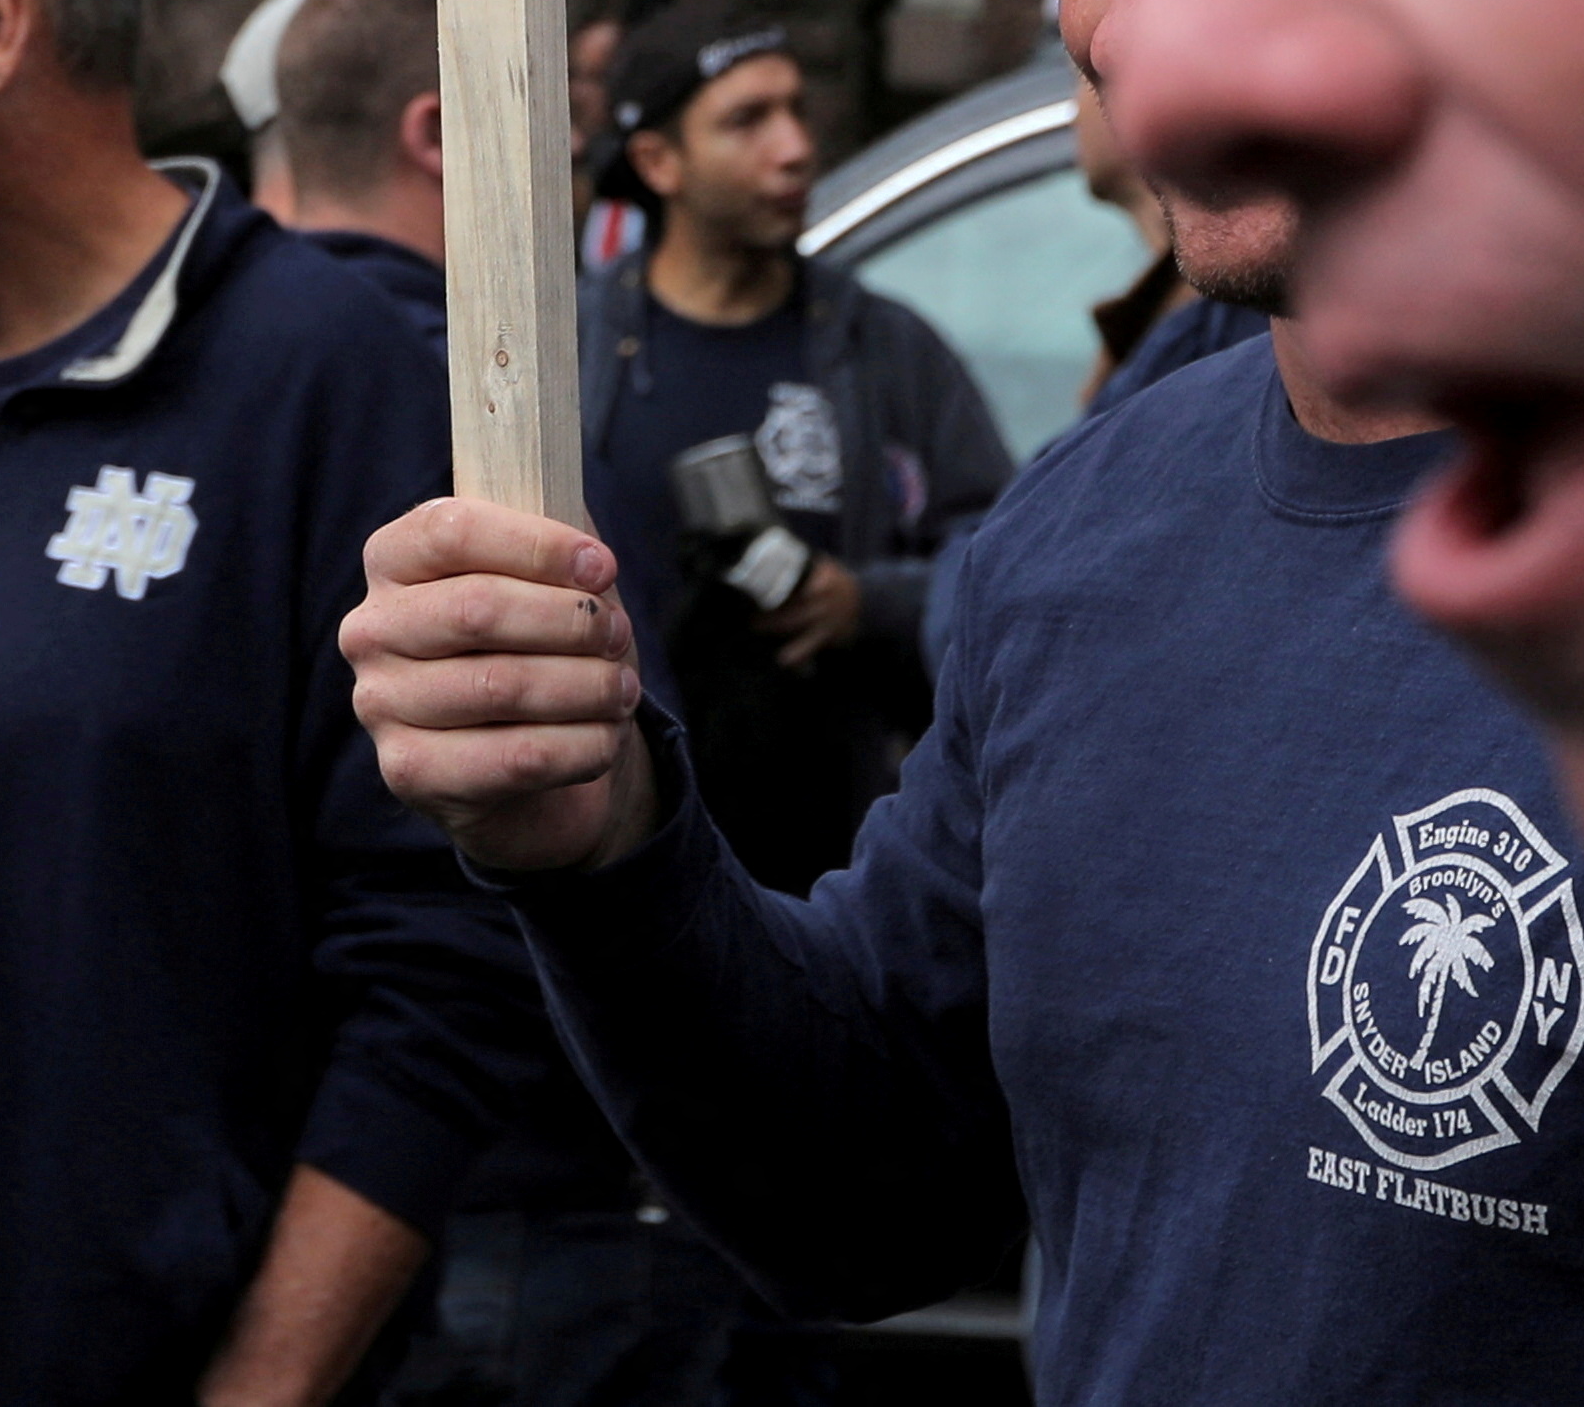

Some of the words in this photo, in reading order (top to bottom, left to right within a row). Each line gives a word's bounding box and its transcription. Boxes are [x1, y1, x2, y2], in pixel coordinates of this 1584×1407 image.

[1418, 819, 1490, 850] Engine
[1492, 831, 1534, 873] 310
[1409, 867, 1506, 919] Brooklyn's
[1353, 982, 1409, 1080] SNYDER
[1424, 1019, 1503, 1085] ISLAND
[1353, 1083, 1428, 1139] Ladder
[1432, 1108, 1473, 1139] 174
[1307, 1146, 1371, 1195] EAST
[1375, 1166, 1550, 1236] FLATBUSH
